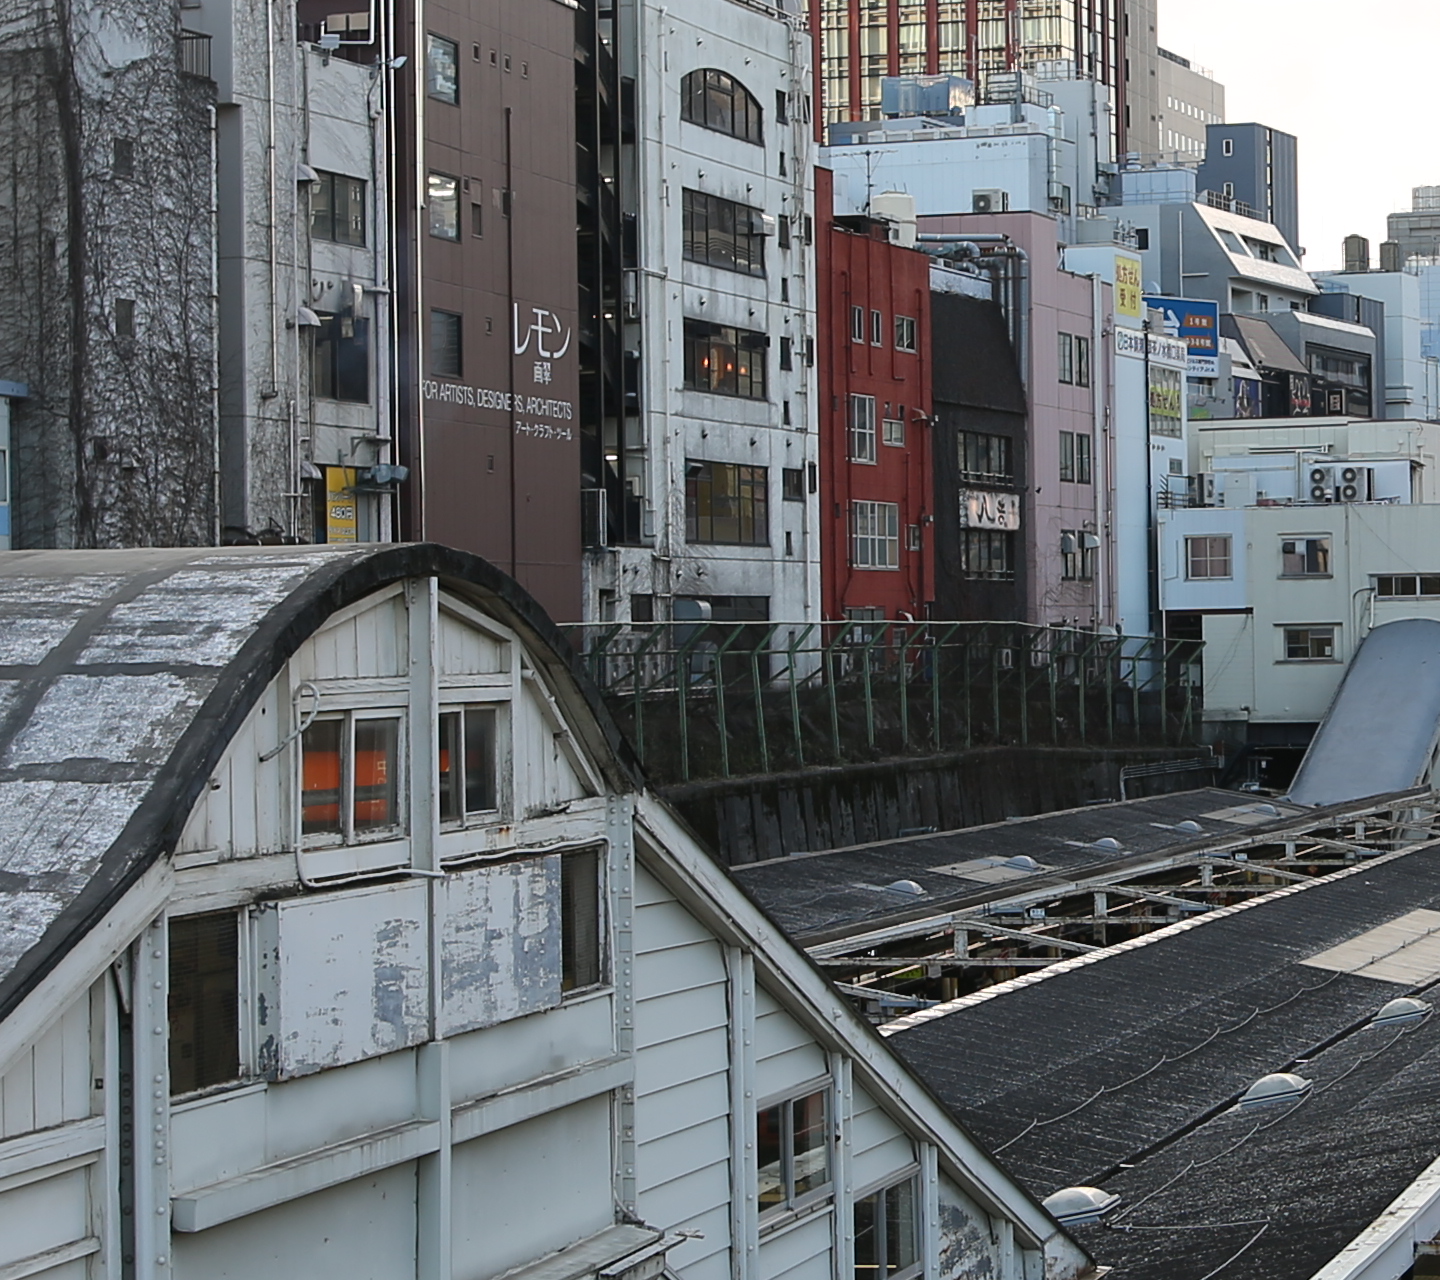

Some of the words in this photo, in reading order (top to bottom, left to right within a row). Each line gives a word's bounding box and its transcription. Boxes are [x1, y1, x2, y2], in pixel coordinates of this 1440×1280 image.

[513, 302, 571, 359] レモン
[526, 396, 572, 420] ARCHITECTS
